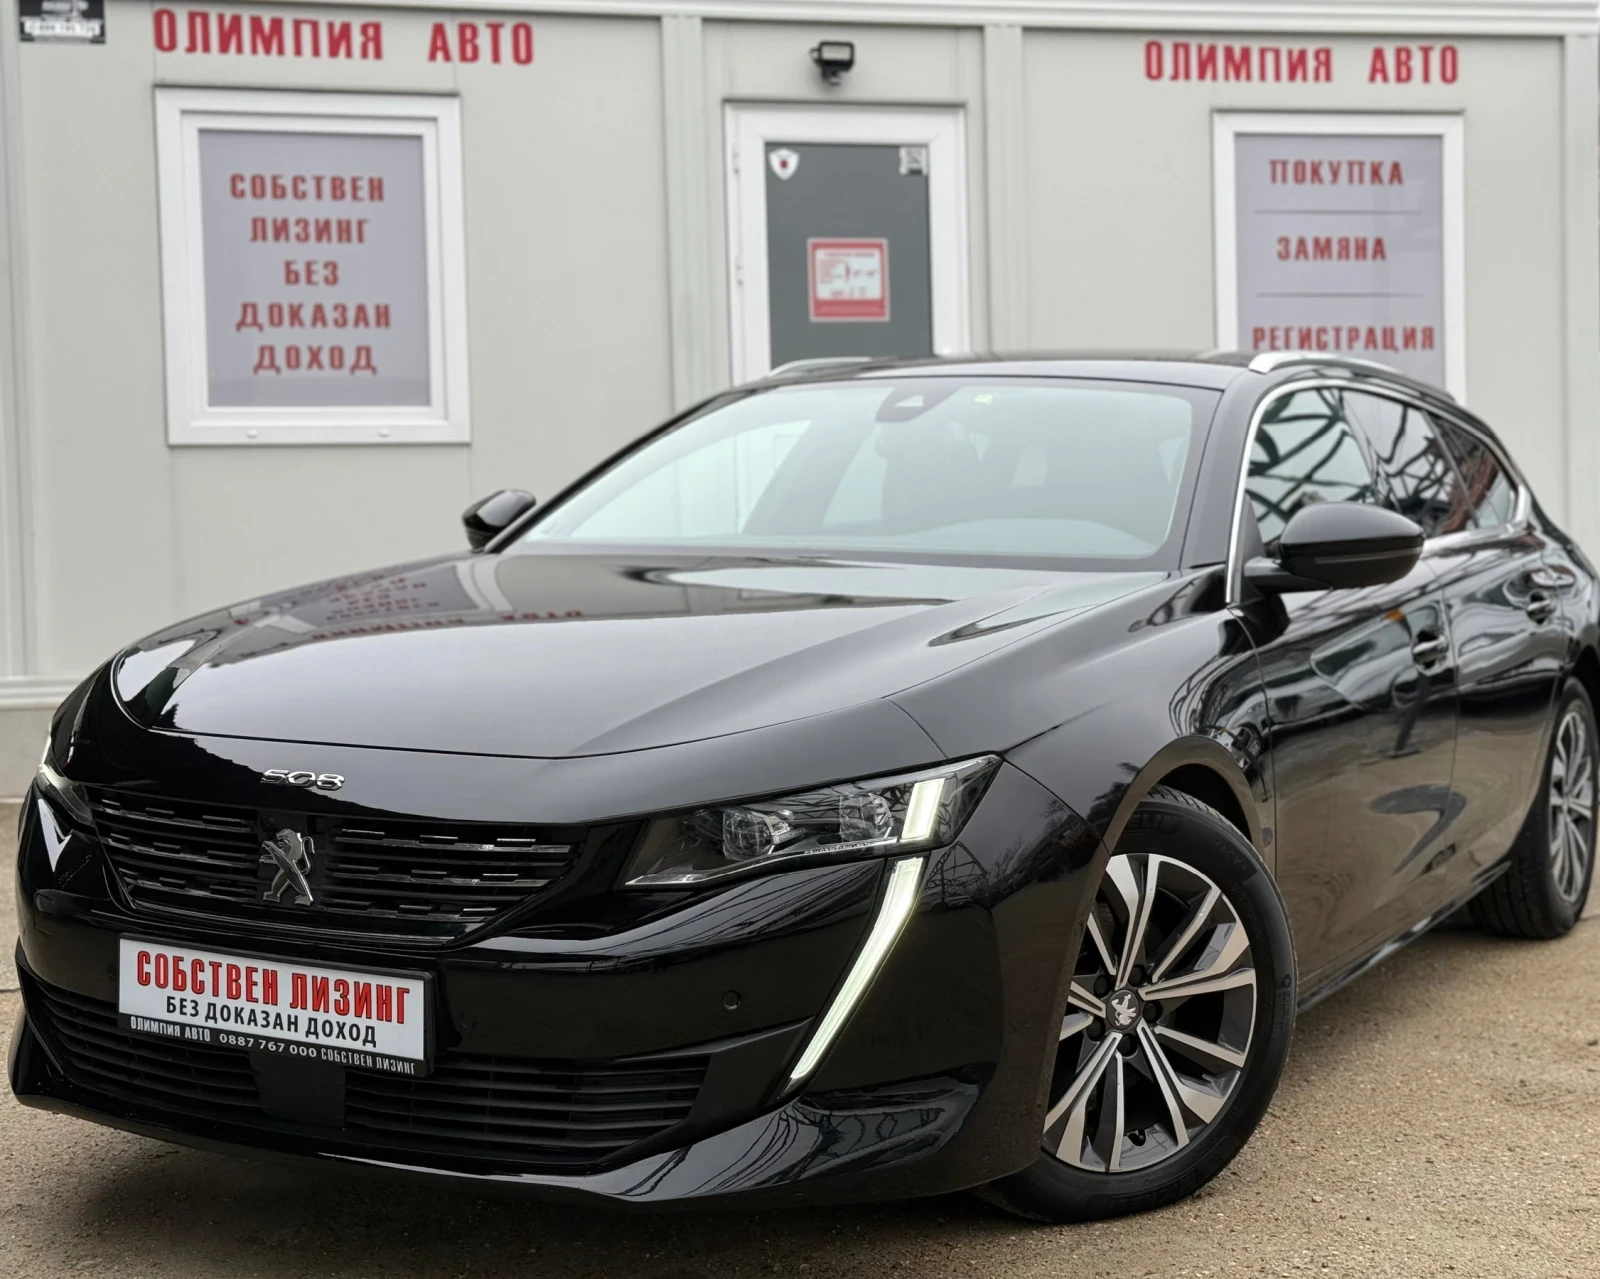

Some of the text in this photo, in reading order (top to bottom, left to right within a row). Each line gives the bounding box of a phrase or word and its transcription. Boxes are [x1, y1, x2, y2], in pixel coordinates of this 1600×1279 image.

[152, 8, 384, 61] ОЛИМПИЯ
[426, 21, 535, 66] АВТО
[1143, 40, 1460, 85] ОЛИМПИЯ АВТО
[1268, 159, 1404, 186] ПОКУПКА
[230, 173, 385, 202] СОБСТВЕН
[250, 217, 369, 244] ЛИЗИНГ
[1277, 236, 1387, 262] ЗАМЯНА
[284, 260, 340, 287] БЕЗ
[236, 302, 391, 332] ДОКАЗАН
[1252, 326, 1435, 353] РЕГИСТРАЦИЯ
[253, 345, 378, 375] ДОХОД
[260, 769, 345, 791] 508
[136, 950, 410, 1025] СОБСТВЕН ЛИЗИНГ
[166, 996, 377, 1048] БЕЗ ДОКАЗАН ДОХОД
[130, 1016, 416, 1075] ОЛИМПИЯ АВТО 0887 767 000 СОБСТВЕН ЛИЗИНГ
